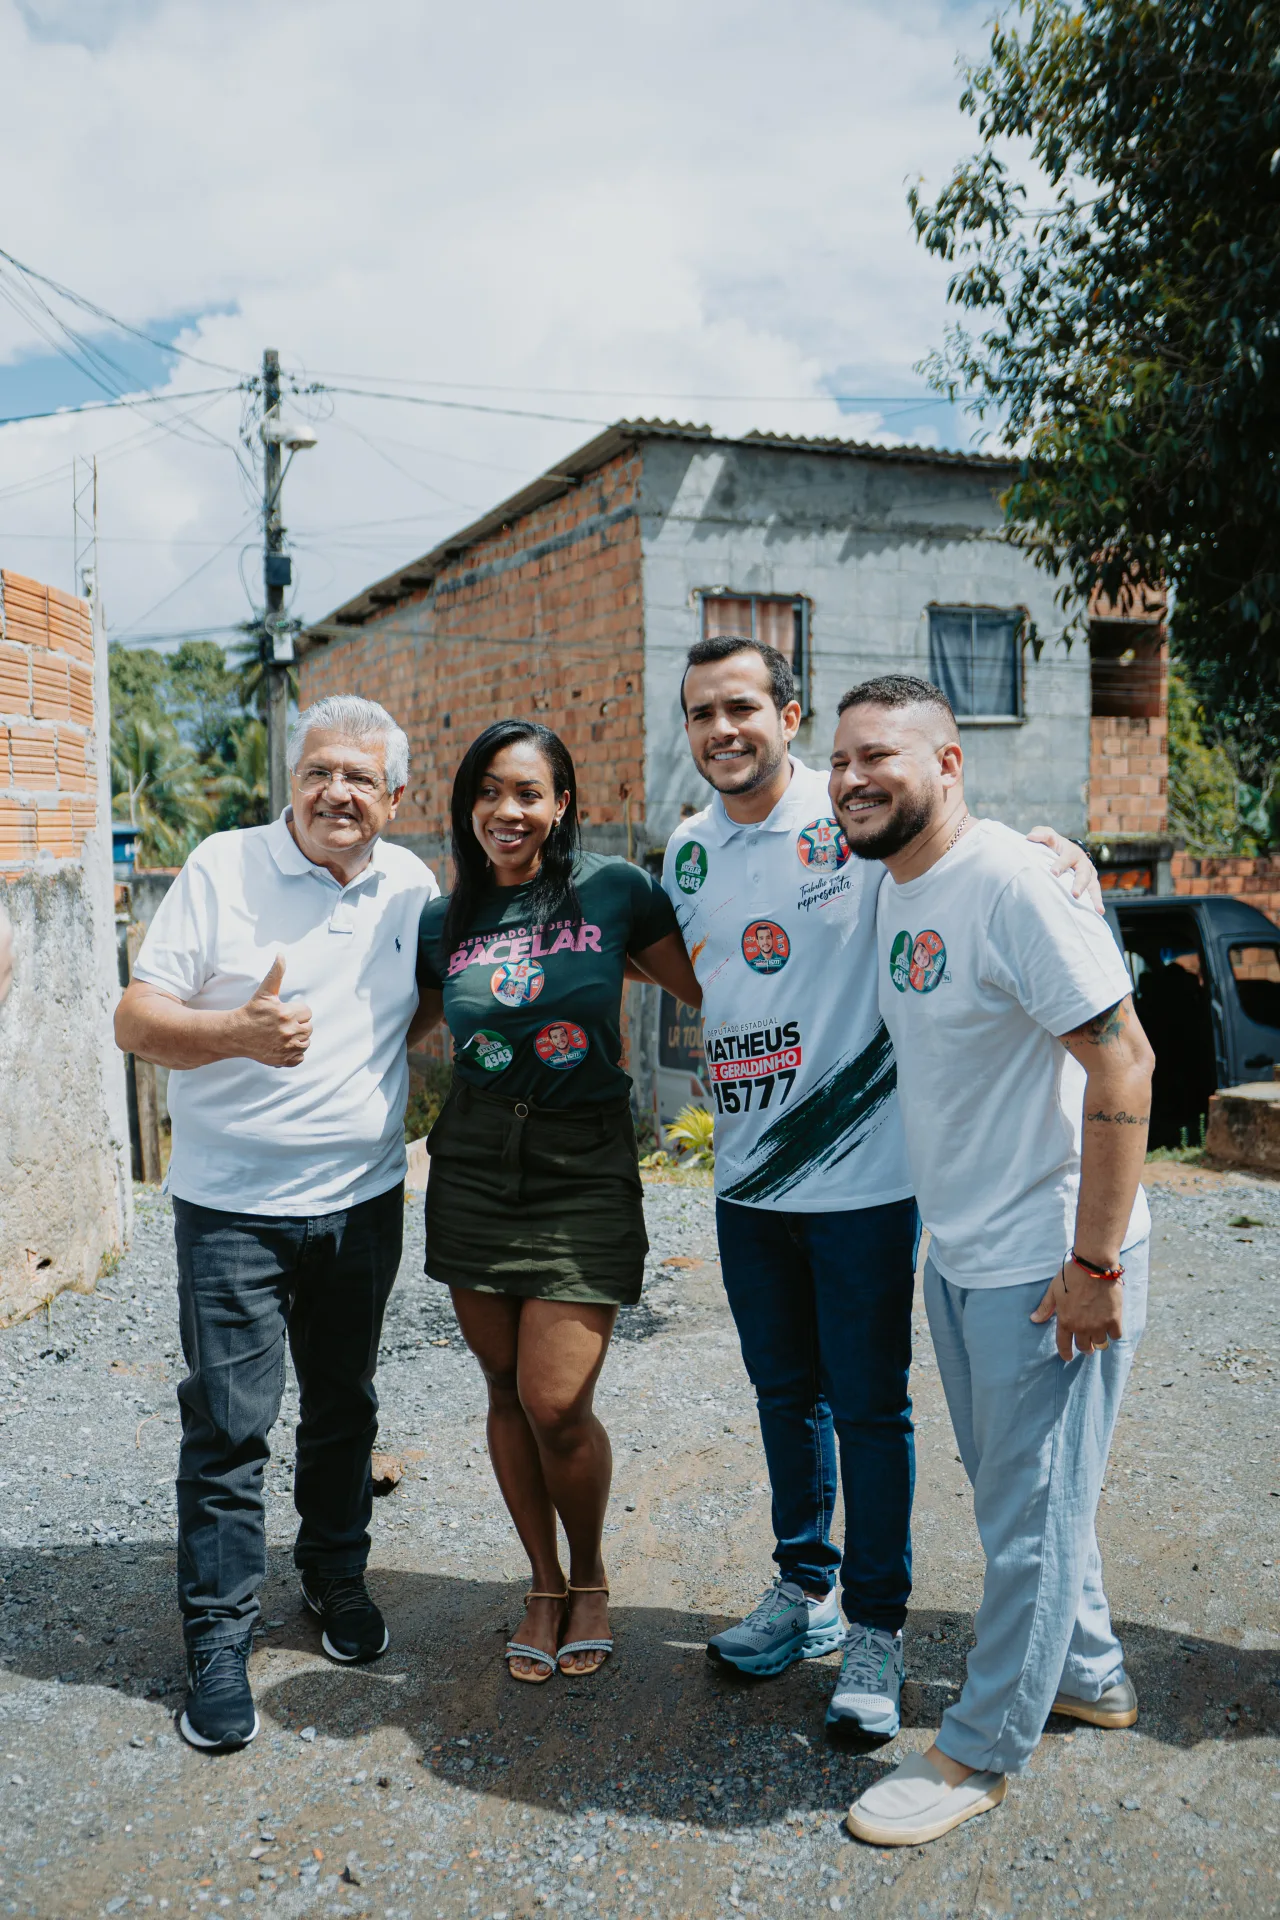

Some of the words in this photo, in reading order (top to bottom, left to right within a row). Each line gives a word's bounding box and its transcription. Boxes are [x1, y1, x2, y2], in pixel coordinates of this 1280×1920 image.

[816, 827, 831, 842] 13
[679, 874, 701, 891] 4343
[800, 878, 827, 897] Trabalho
[459, 927, 527, 949] DEPUTADO
[531, 917, 588, 935] FEDERL
[447, 924, 602, 977] BACELAR
[515, 965, 529, 978] 13
[740, 1017, 778, 1032] ESTADUAL
[705, 1021, 801, 1063] MATHEUS
[484, 1048, 513, 1068] 4343
[720, 1050, 798, 1080] GERALDINHO
[713, 1068, 797, 1115] 15777
